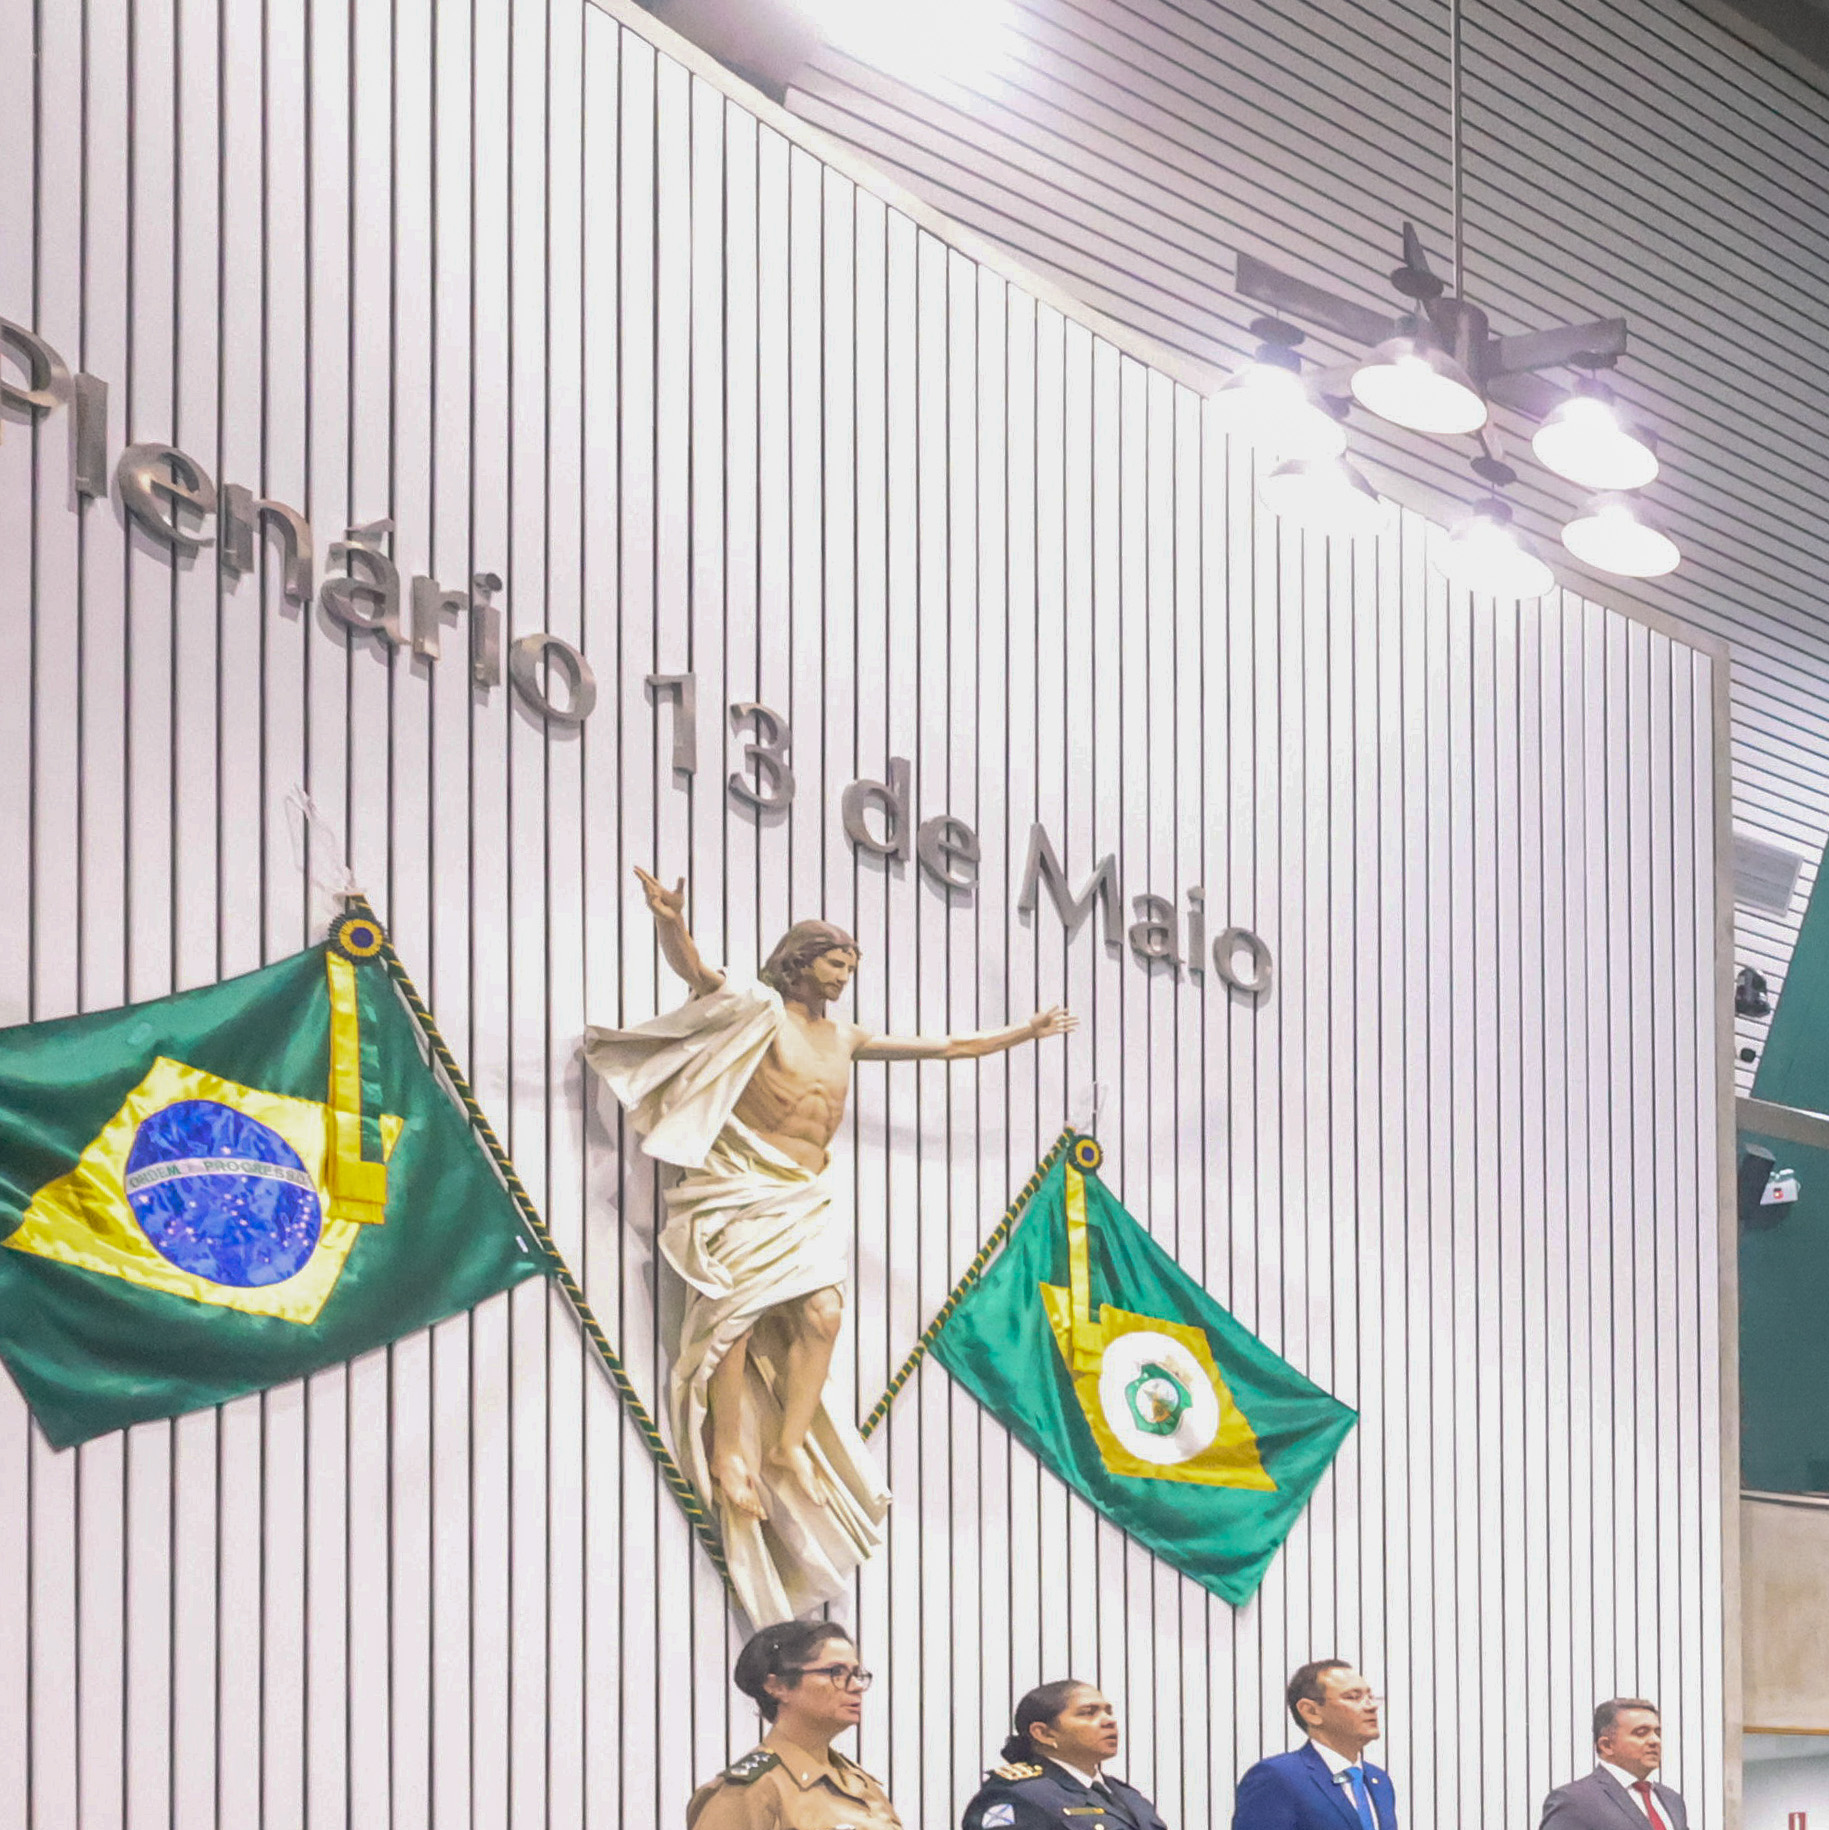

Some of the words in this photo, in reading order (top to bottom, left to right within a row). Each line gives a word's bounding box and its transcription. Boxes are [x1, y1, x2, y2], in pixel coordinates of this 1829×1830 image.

[646, 671, 796, 810] 13
[841, 756, 980, 890] de
[1018, 822, 1273, 993] Maio
